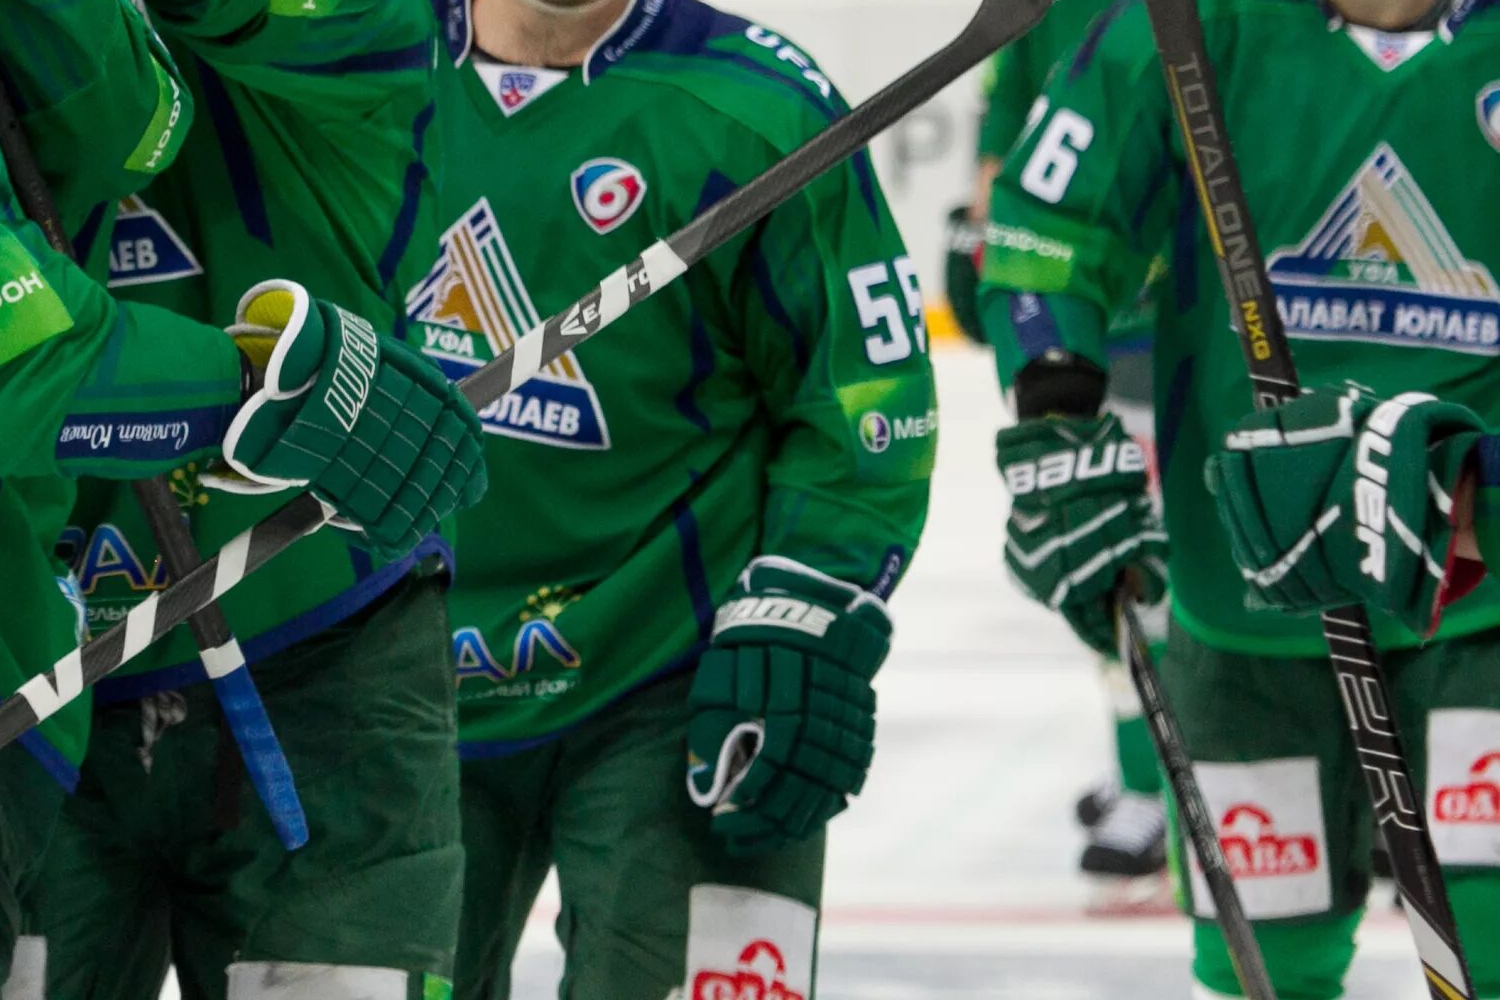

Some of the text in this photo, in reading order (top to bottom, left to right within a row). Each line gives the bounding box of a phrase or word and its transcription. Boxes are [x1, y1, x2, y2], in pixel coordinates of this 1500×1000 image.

[1347, 261, 1401, 284] УФА
[423, 324, 475, 358] УФА
[1241, 300, 1271, 361] NXG
[1276, 295, 1500, 346] АЛАВАТ ЮЛАЕВ
[1004, 439, 1147, 496] BAUE
